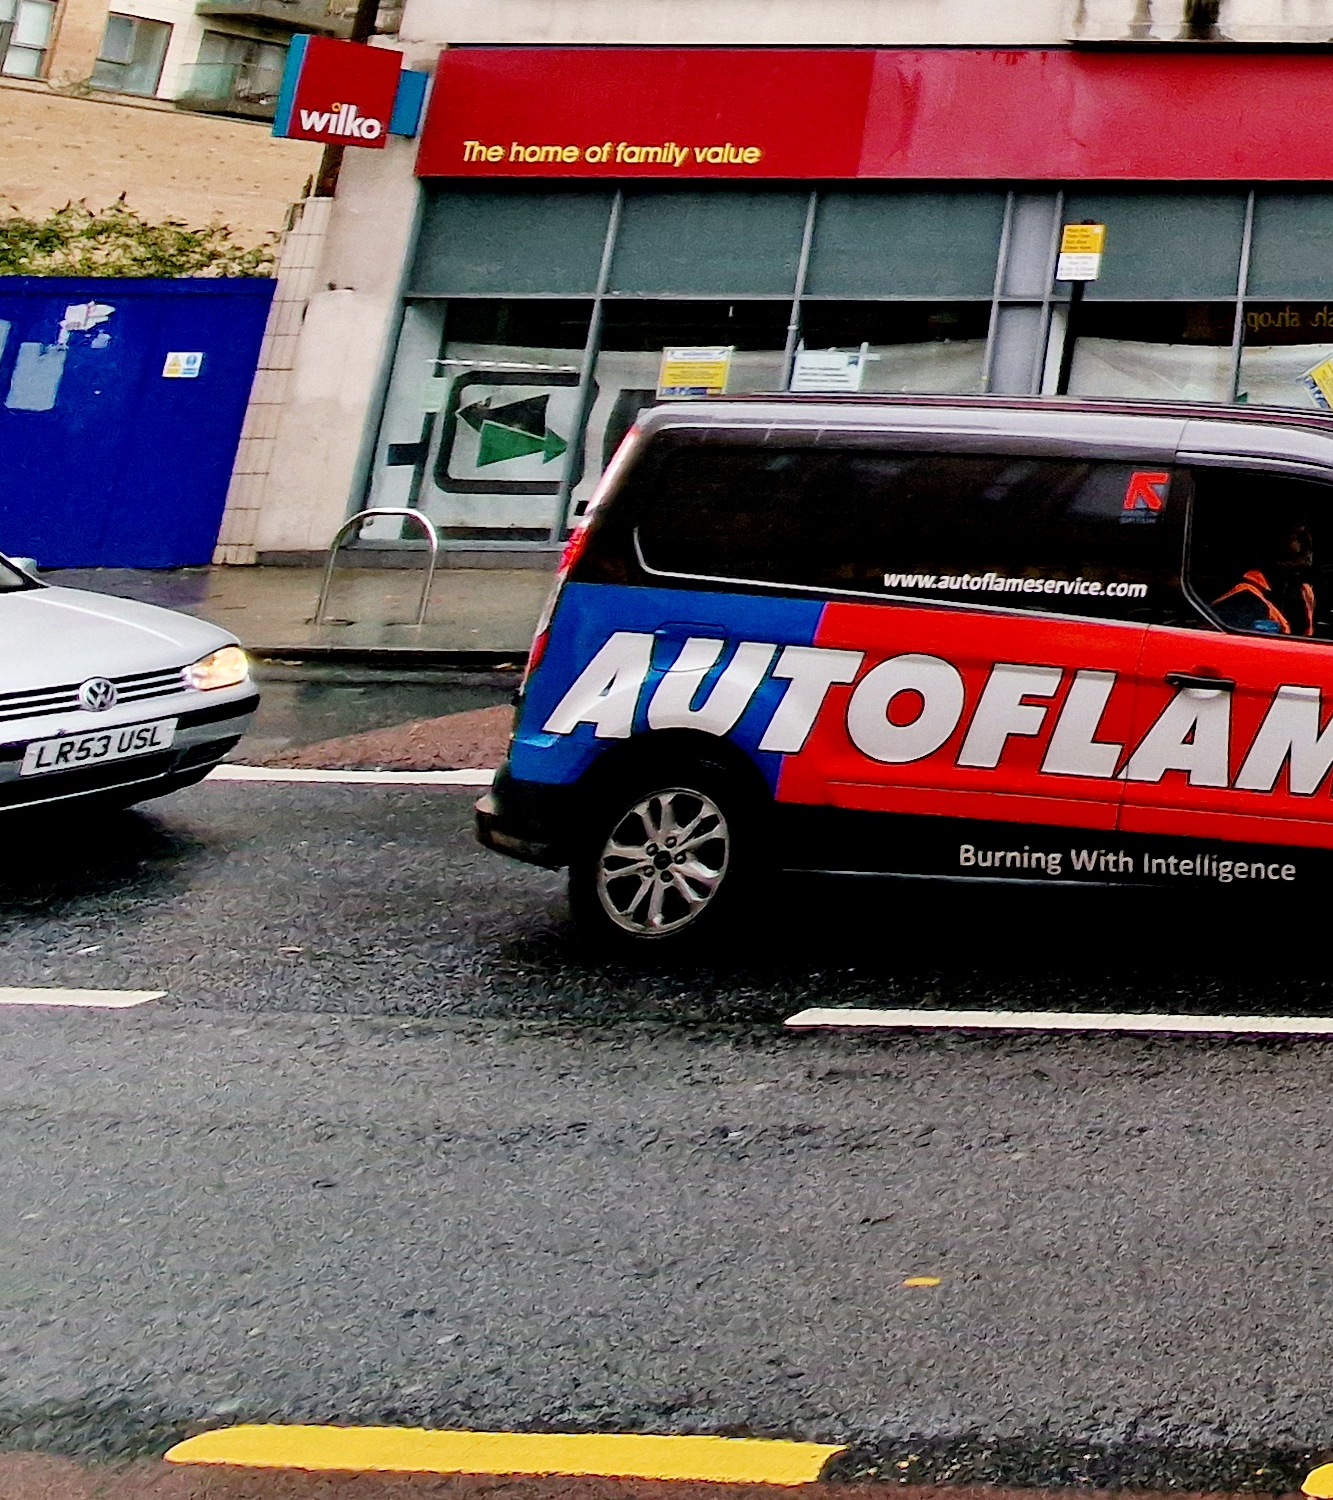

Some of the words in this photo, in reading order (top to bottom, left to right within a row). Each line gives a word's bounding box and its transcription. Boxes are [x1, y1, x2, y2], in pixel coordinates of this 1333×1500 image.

[299, 102, 382, 140] wilko
[462, 140, 505, 163] The
[509, 141, 580, 164] home
[583, 142, 612, 164] of
[614, 141, 690, 167] family
[693, 143, 762, 164] value
[883, 570, 1148, 599] www.autoflameservice.com
[35, 734, 112, 769] LR53
[117, 725, 162, 754] USL
[958, 843, 1062, 875] Burning
[1070, 847, 1134, 874] With
[1142, 851, 1297, 883] Intelligence
